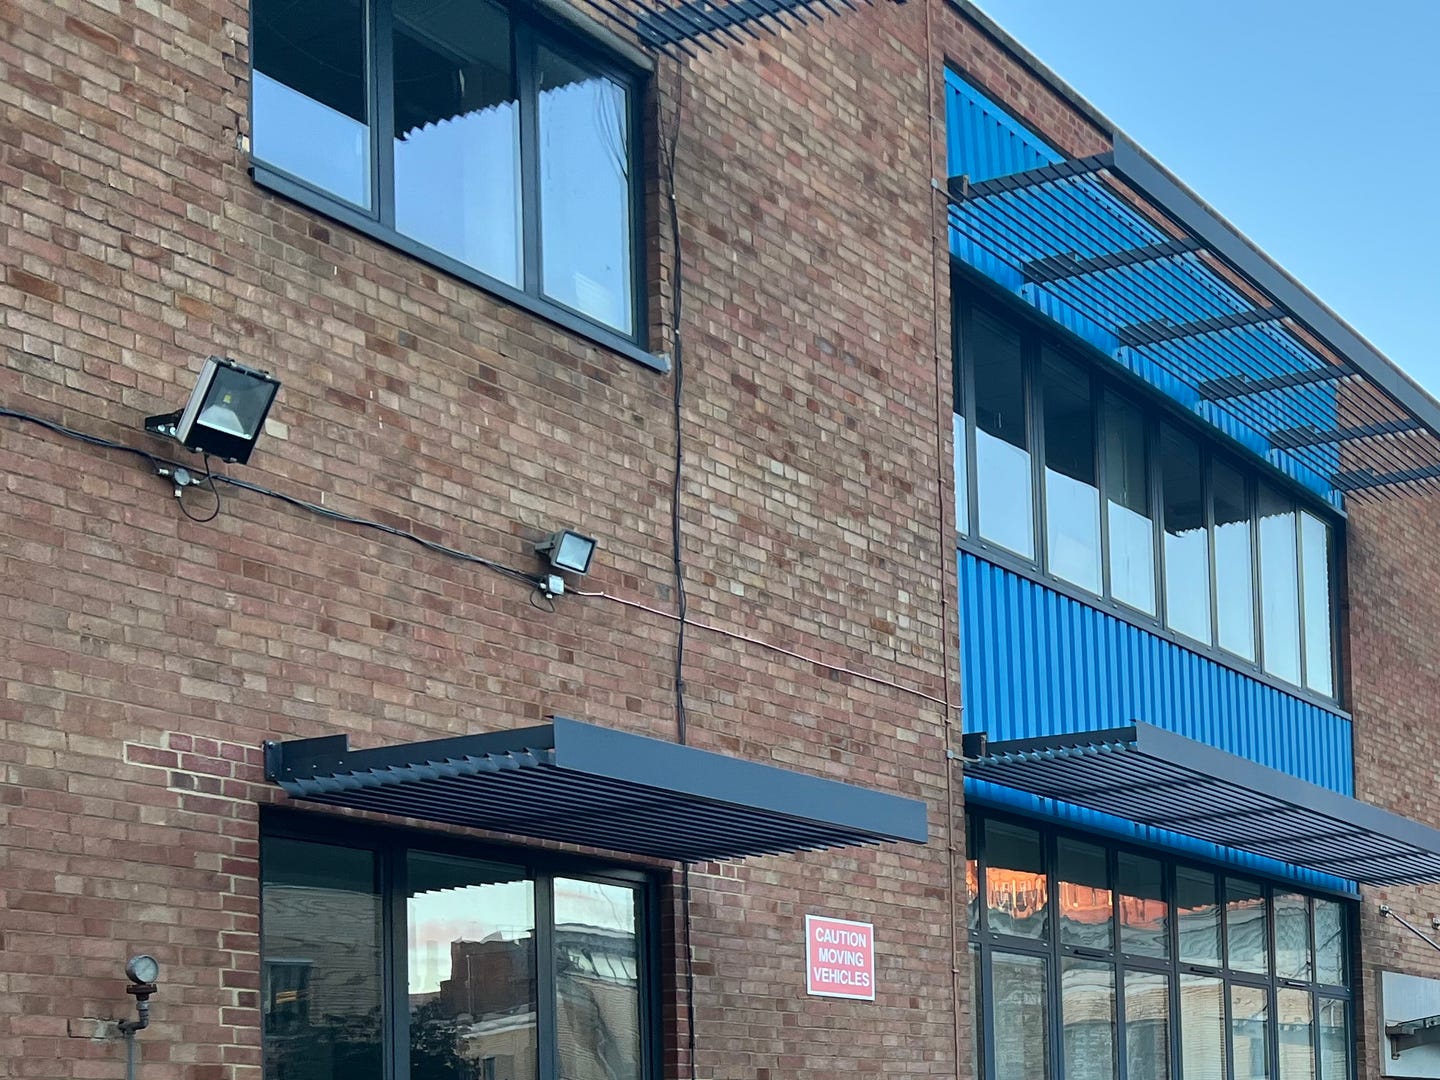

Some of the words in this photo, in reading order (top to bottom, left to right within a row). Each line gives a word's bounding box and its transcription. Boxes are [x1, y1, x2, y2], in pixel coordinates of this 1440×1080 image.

[815, 927, 867, 948] CAUTION
[818, 947, 865, 967] MOVING
[813, 966, 871, 987] VEHICLES
